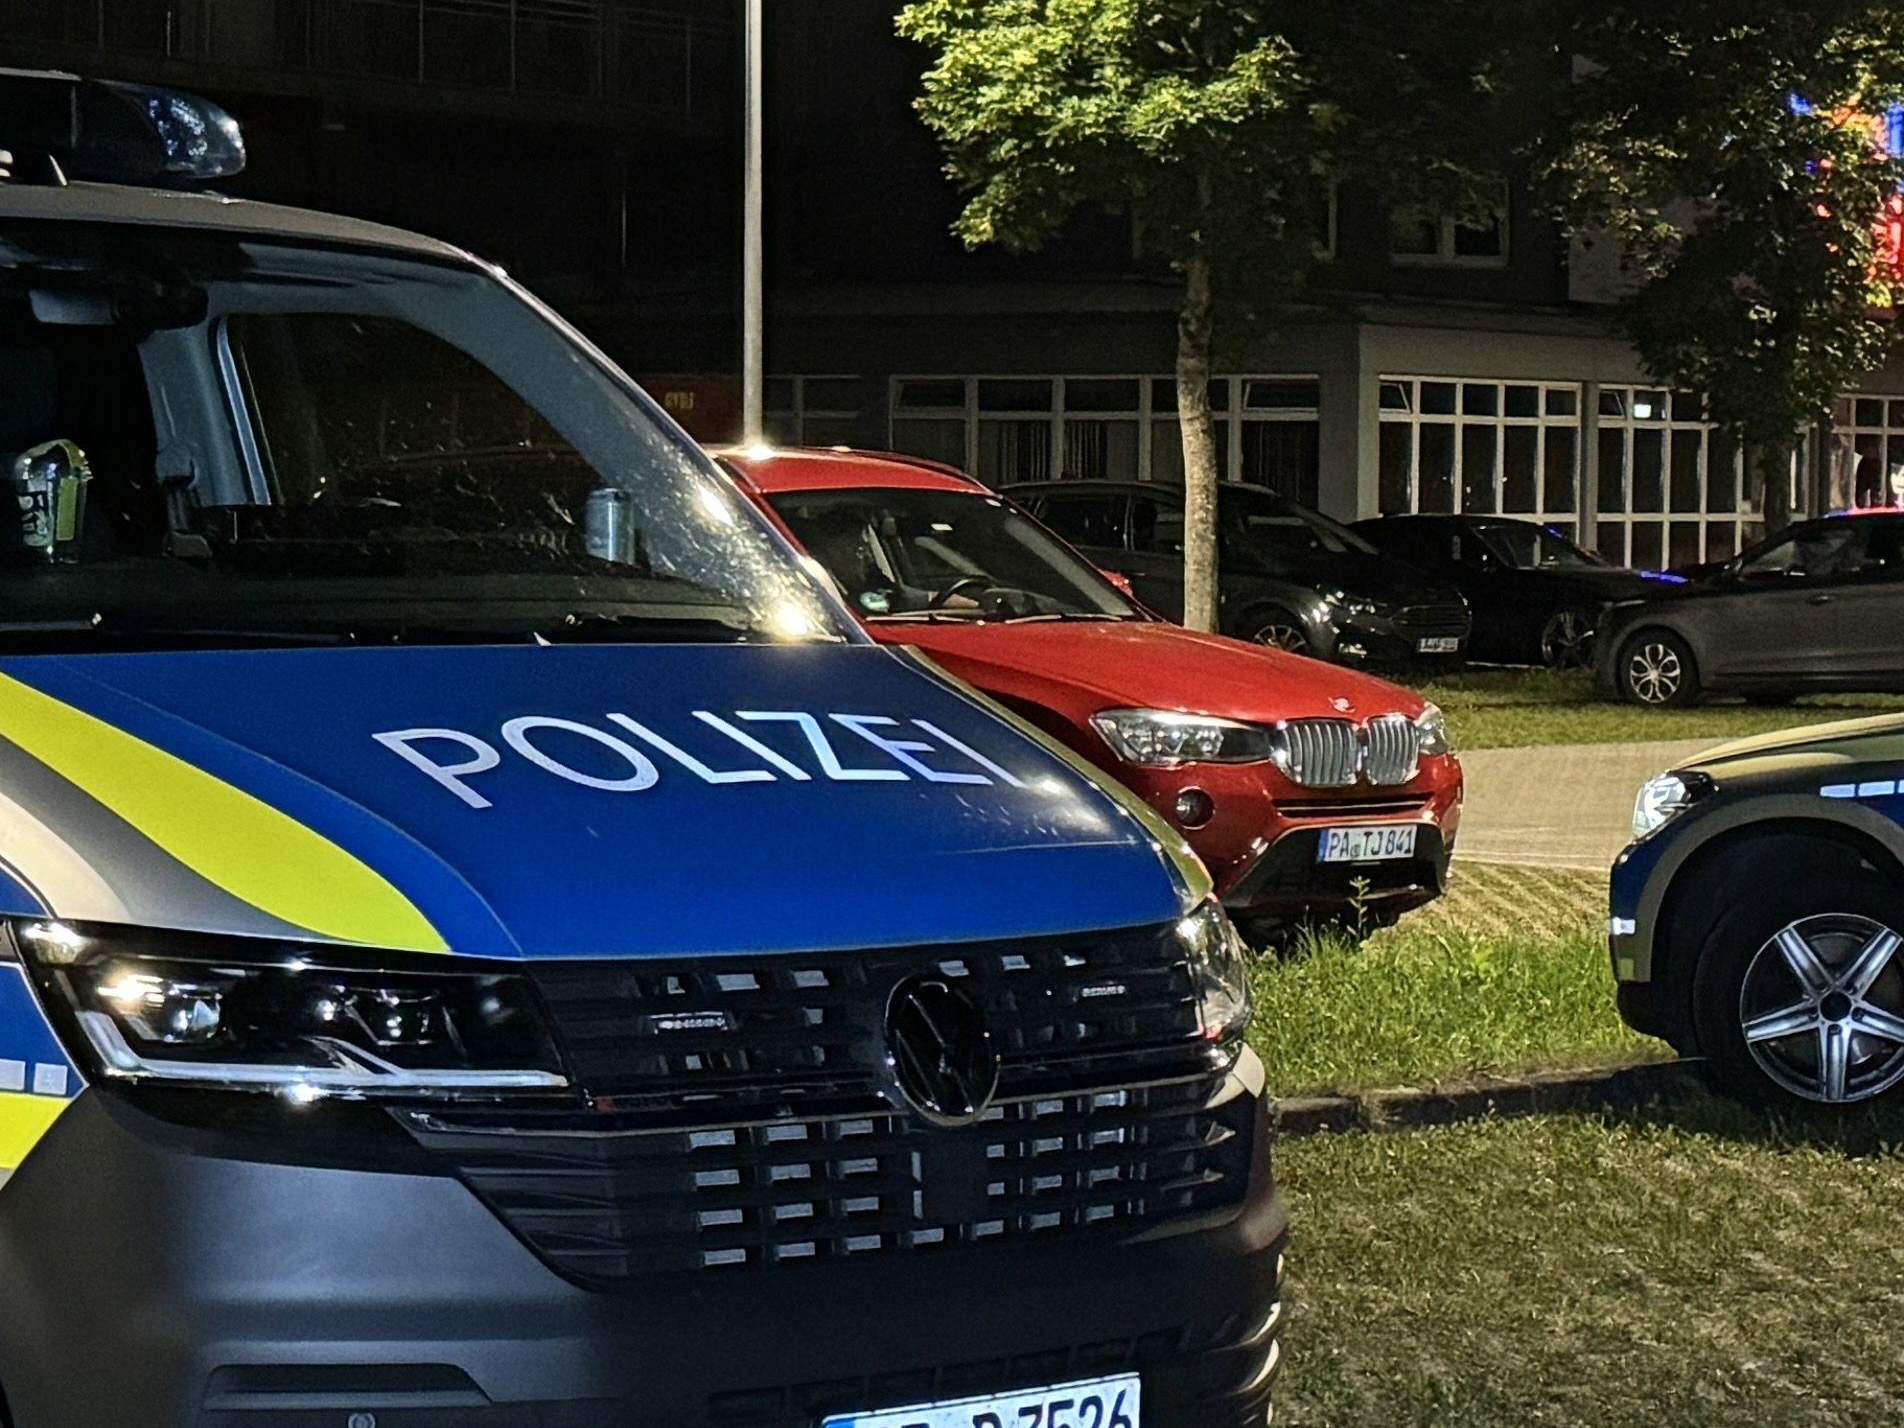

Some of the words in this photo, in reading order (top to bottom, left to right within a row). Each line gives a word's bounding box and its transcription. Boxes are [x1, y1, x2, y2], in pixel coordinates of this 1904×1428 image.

[371, 710, 1026, 809] POLIZEI
[1328, 832, 1350, 858] PA
[1362, 831, 1385, 856] TJ
[1385, 829, 1413, 855] 841
